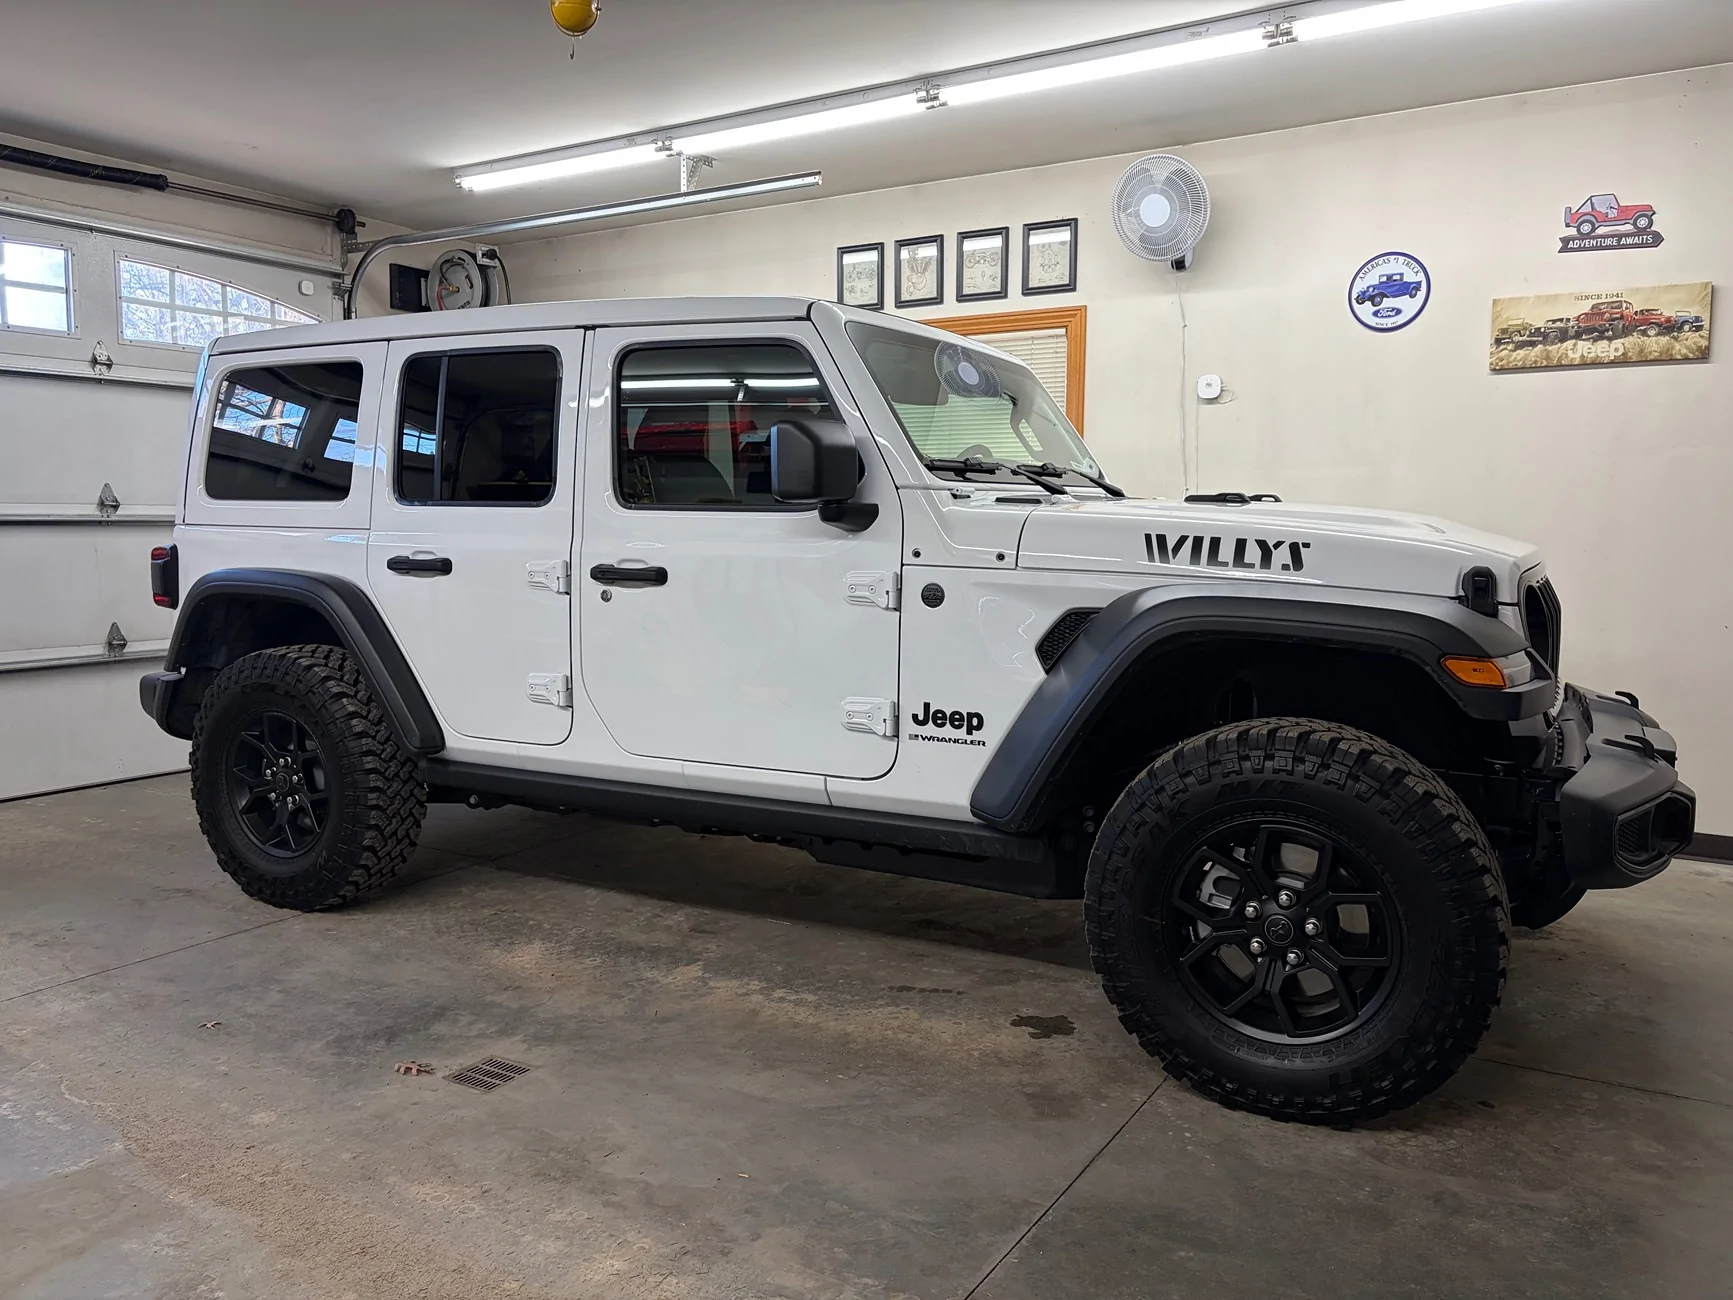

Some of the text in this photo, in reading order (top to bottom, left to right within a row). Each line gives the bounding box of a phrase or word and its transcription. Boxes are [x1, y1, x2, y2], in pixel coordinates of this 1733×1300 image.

[1568, 235, 1653, 248] ADVENTURE AWAITS
[1402, 259, 1421, 276] TRUCK
[1574, 293, 1603, 301] SINCE
[1377, 309, 1396, 317] Ford
[1568, 340, 1624, 360] Jeep
[1144, 533, 1311, 572] WILLYS
[911, 701, 984, 736] Jeep
[919, 734, 987, 747] WRANGLER
